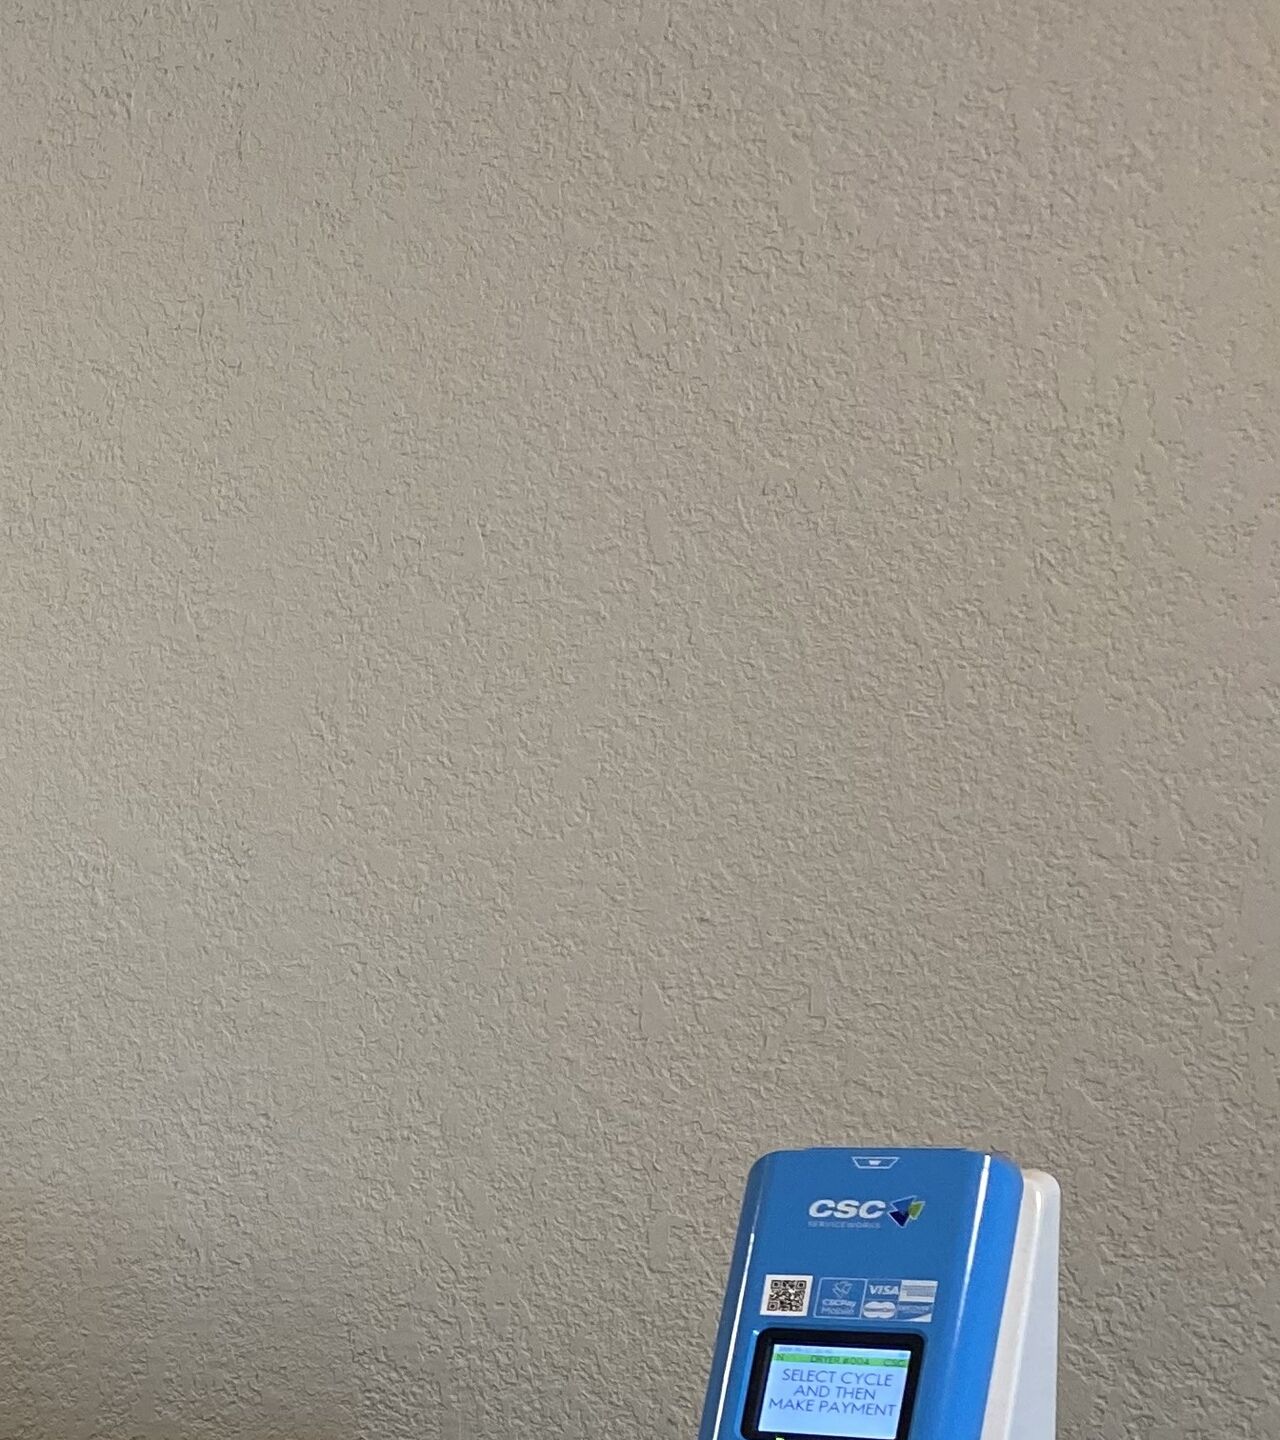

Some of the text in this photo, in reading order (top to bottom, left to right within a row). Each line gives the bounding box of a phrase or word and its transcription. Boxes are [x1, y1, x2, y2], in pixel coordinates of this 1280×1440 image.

[809, 1199, 886, 1219] CSC
[869, 1284, 899, 1296] VISA
[782, 1368, 894, 1387] SELECT CYCLE
[793, 1385, 877, 1401] AND THEN
[769, 1398, 897, 1416] MAKE PAYMENT
